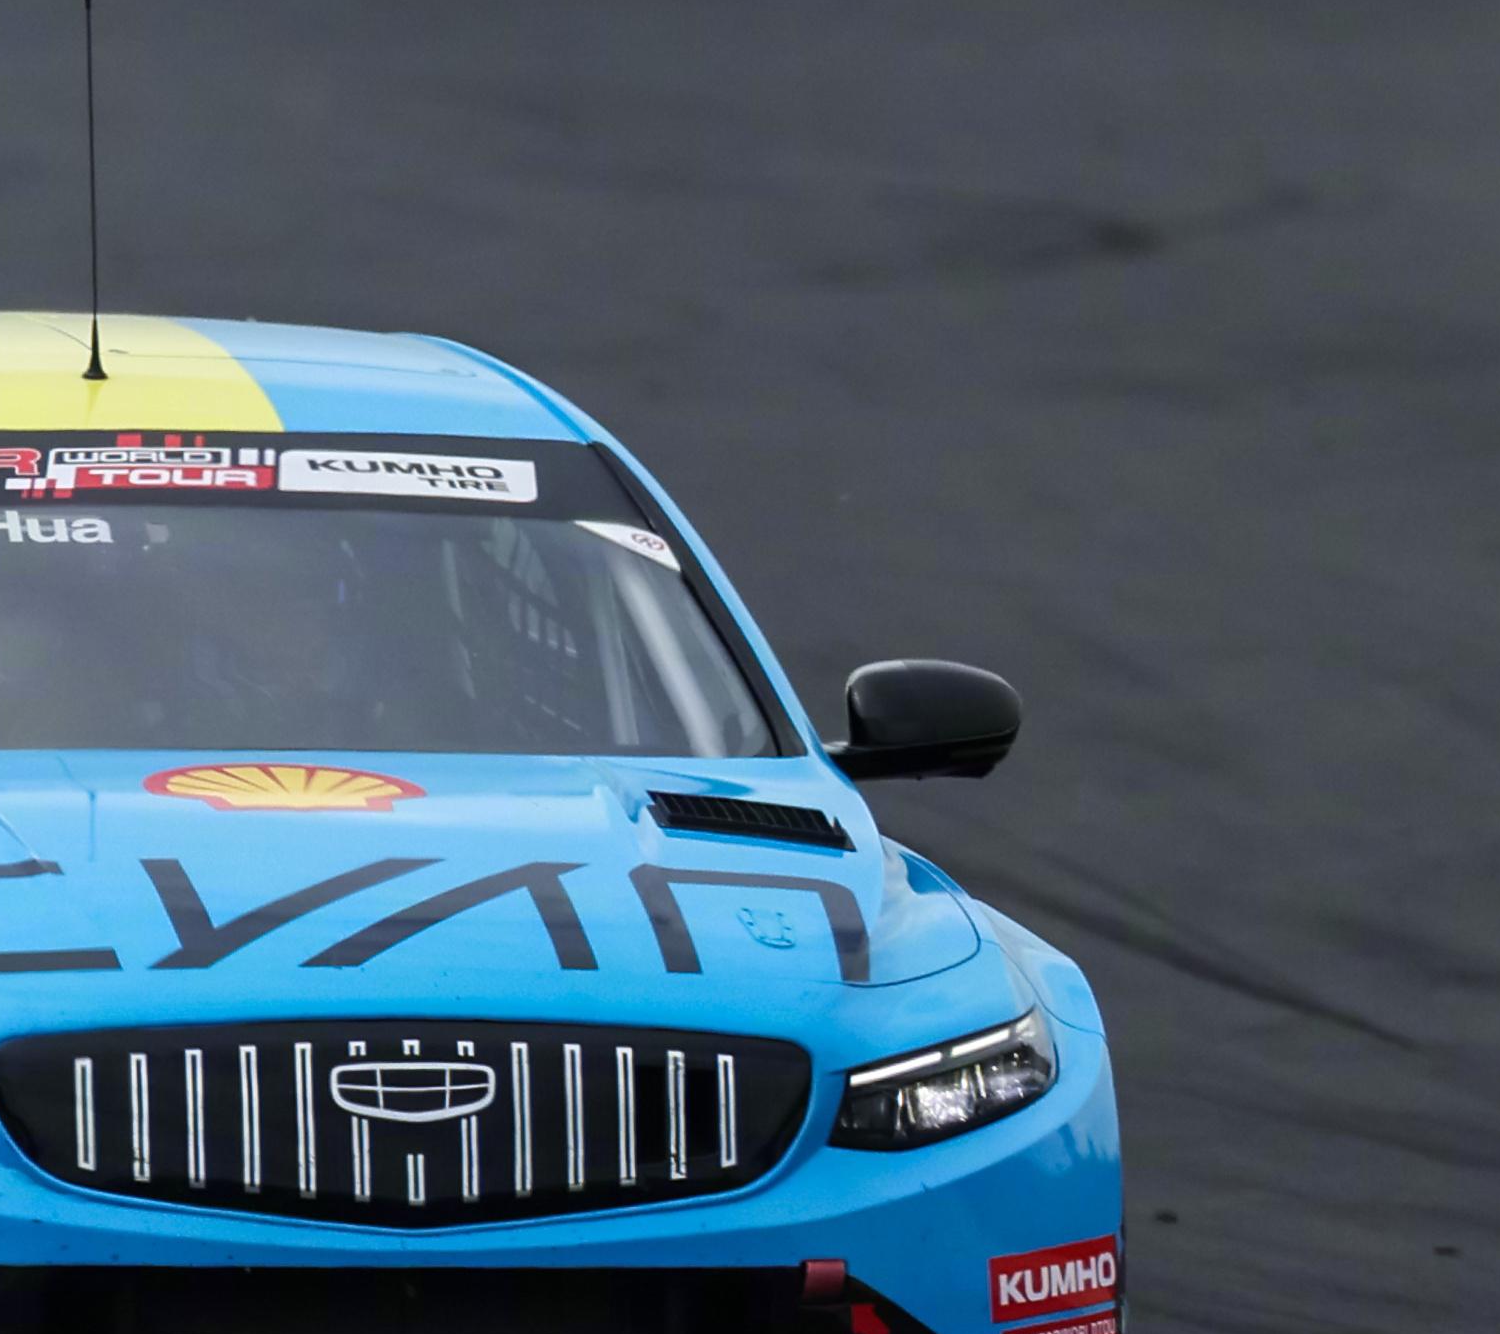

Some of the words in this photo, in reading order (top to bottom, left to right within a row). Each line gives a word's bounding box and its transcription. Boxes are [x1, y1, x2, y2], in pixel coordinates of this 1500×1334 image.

[62, 449, 213, 466] WORLD
[87, 467, 259, 488] TOUR
[306, 457, 503, 481] KUMHO
[416, 476, 511, 493] TIRE
[998, 1251, 1117, 1306] KUMHO
